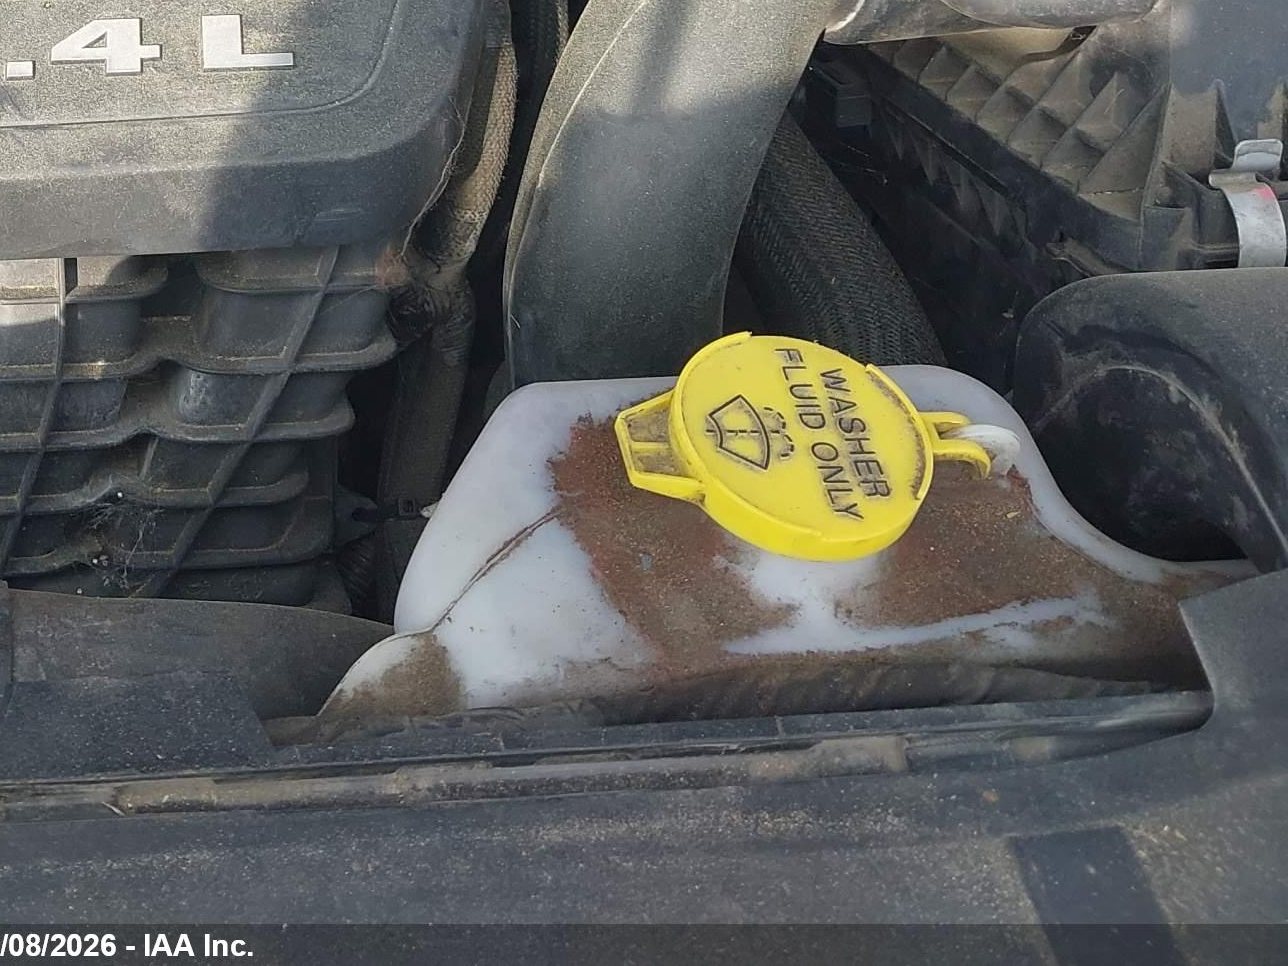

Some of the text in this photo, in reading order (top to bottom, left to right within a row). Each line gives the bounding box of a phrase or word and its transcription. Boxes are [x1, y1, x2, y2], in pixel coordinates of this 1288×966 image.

[774, 347, 865, 520] FLUID ONLY
[819, 367, 891, 498] WASHER
